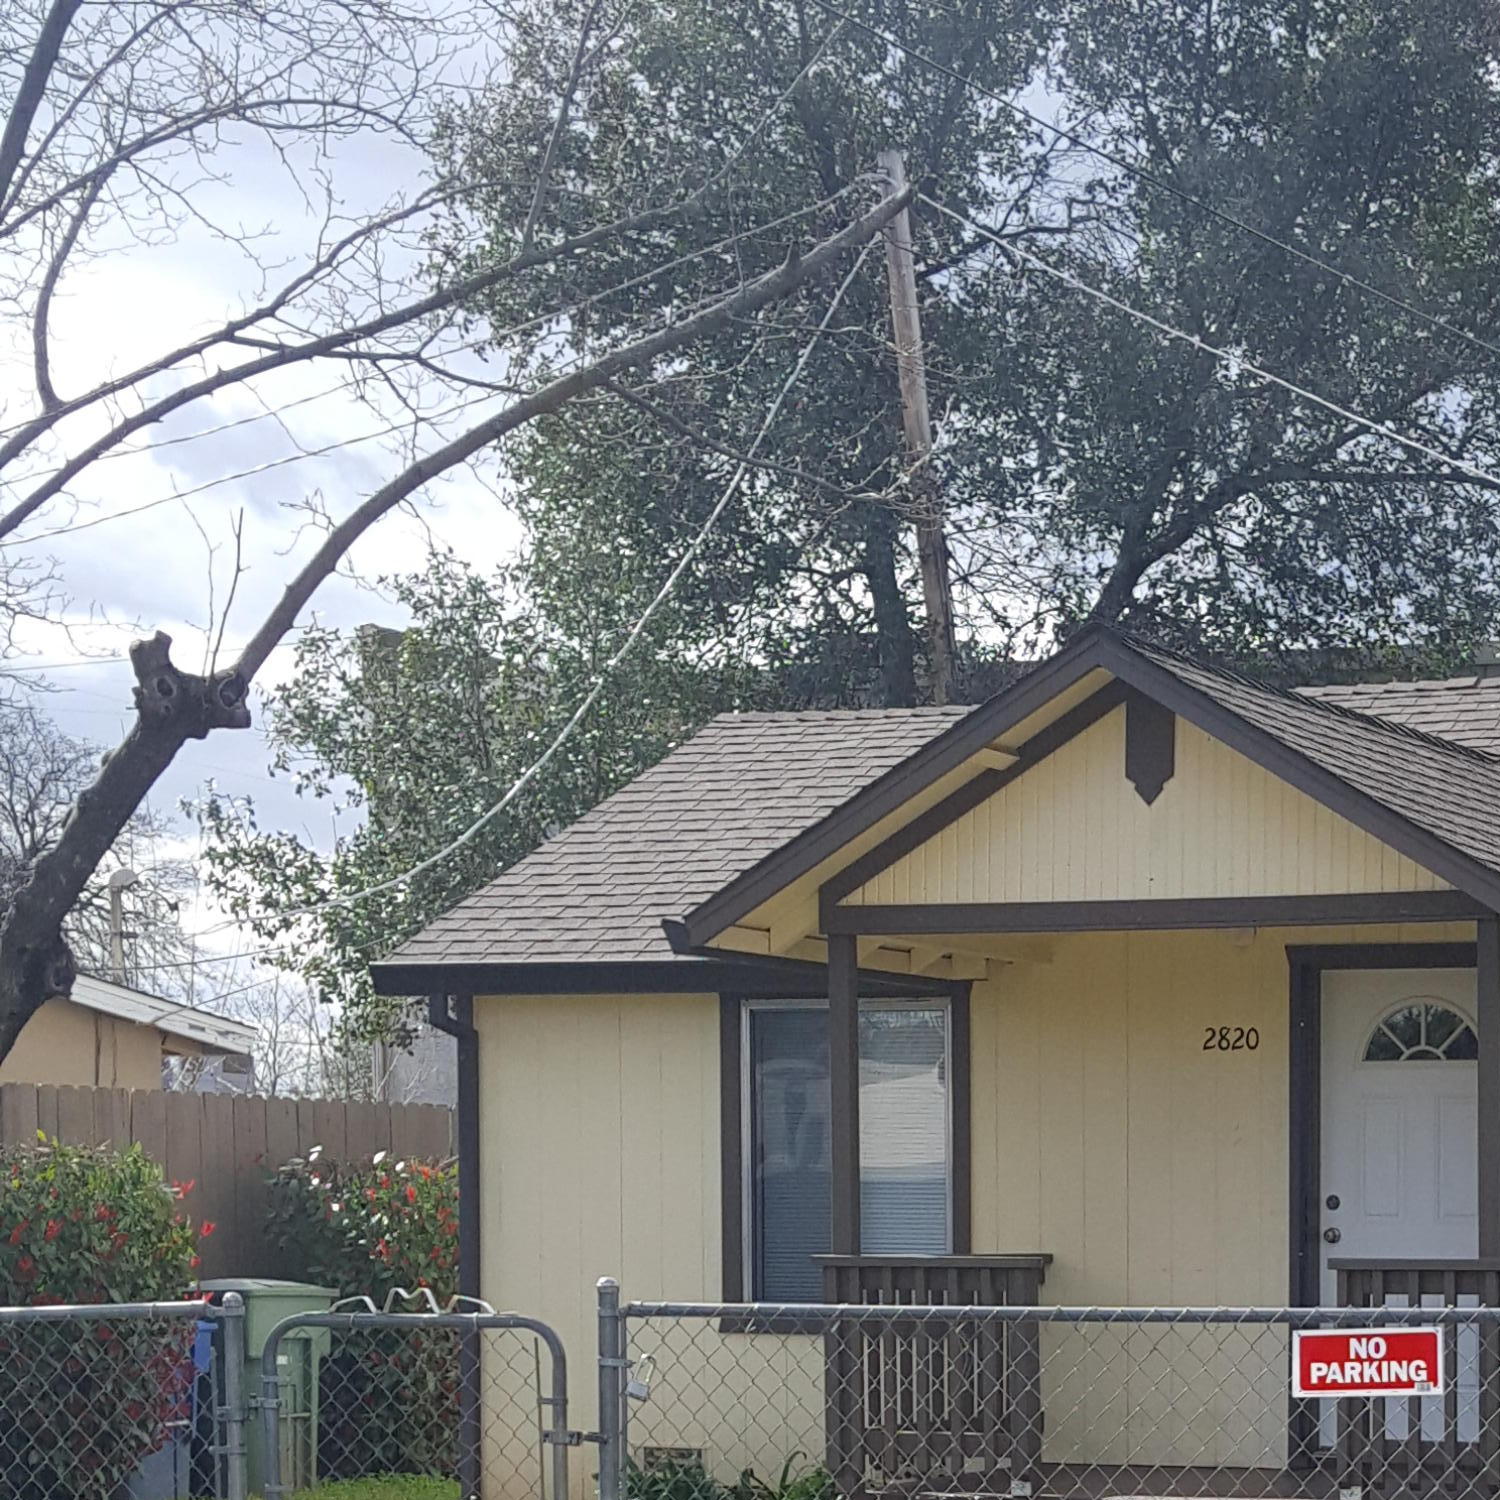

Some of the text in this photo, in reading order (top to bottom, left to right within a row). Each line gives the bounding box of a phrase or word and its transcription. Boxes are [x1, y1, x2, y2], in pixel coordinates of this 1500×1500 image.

[1203, 1026, 1260, 1051] 2820
[1349, 1336, 1387, 1360] NO
[1310, 1359, 1428, 1384] PARKING
